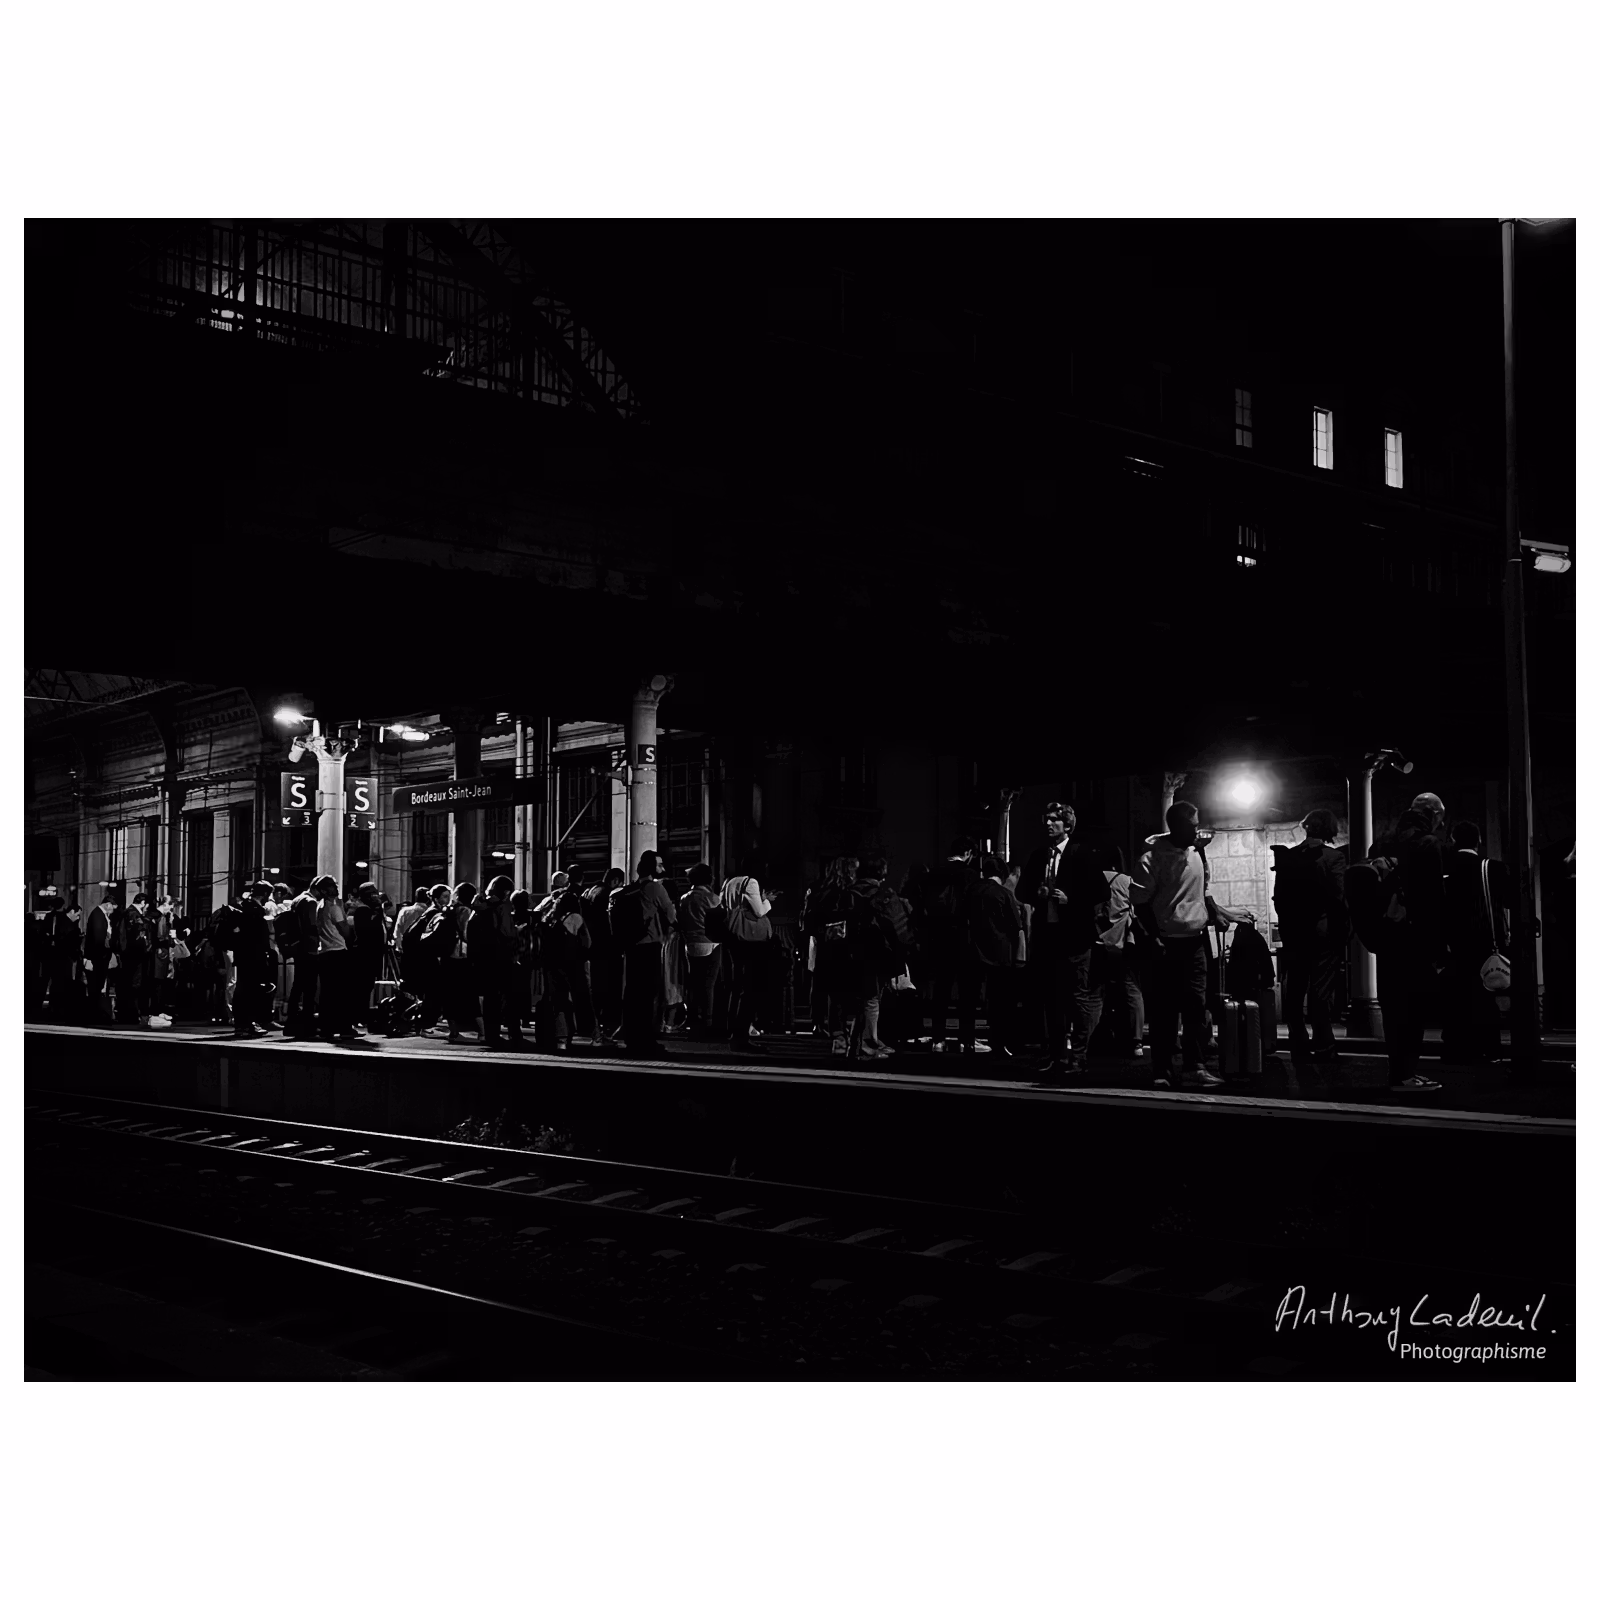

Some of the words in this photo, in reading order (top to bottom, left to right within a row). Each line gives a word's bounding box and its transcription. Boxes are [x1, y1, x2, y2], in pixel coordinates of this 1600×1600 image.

[645, 747, 655, 763] S
[291, 782, 307, 808] S
[354, 787, 370, 812] S
[411, 791, 446, 805] Bordeaux
[448, 785, 491, 800] Saint-Jean
[304, 816, 310, 824] 3
[350, 818, 356, 826] 2
